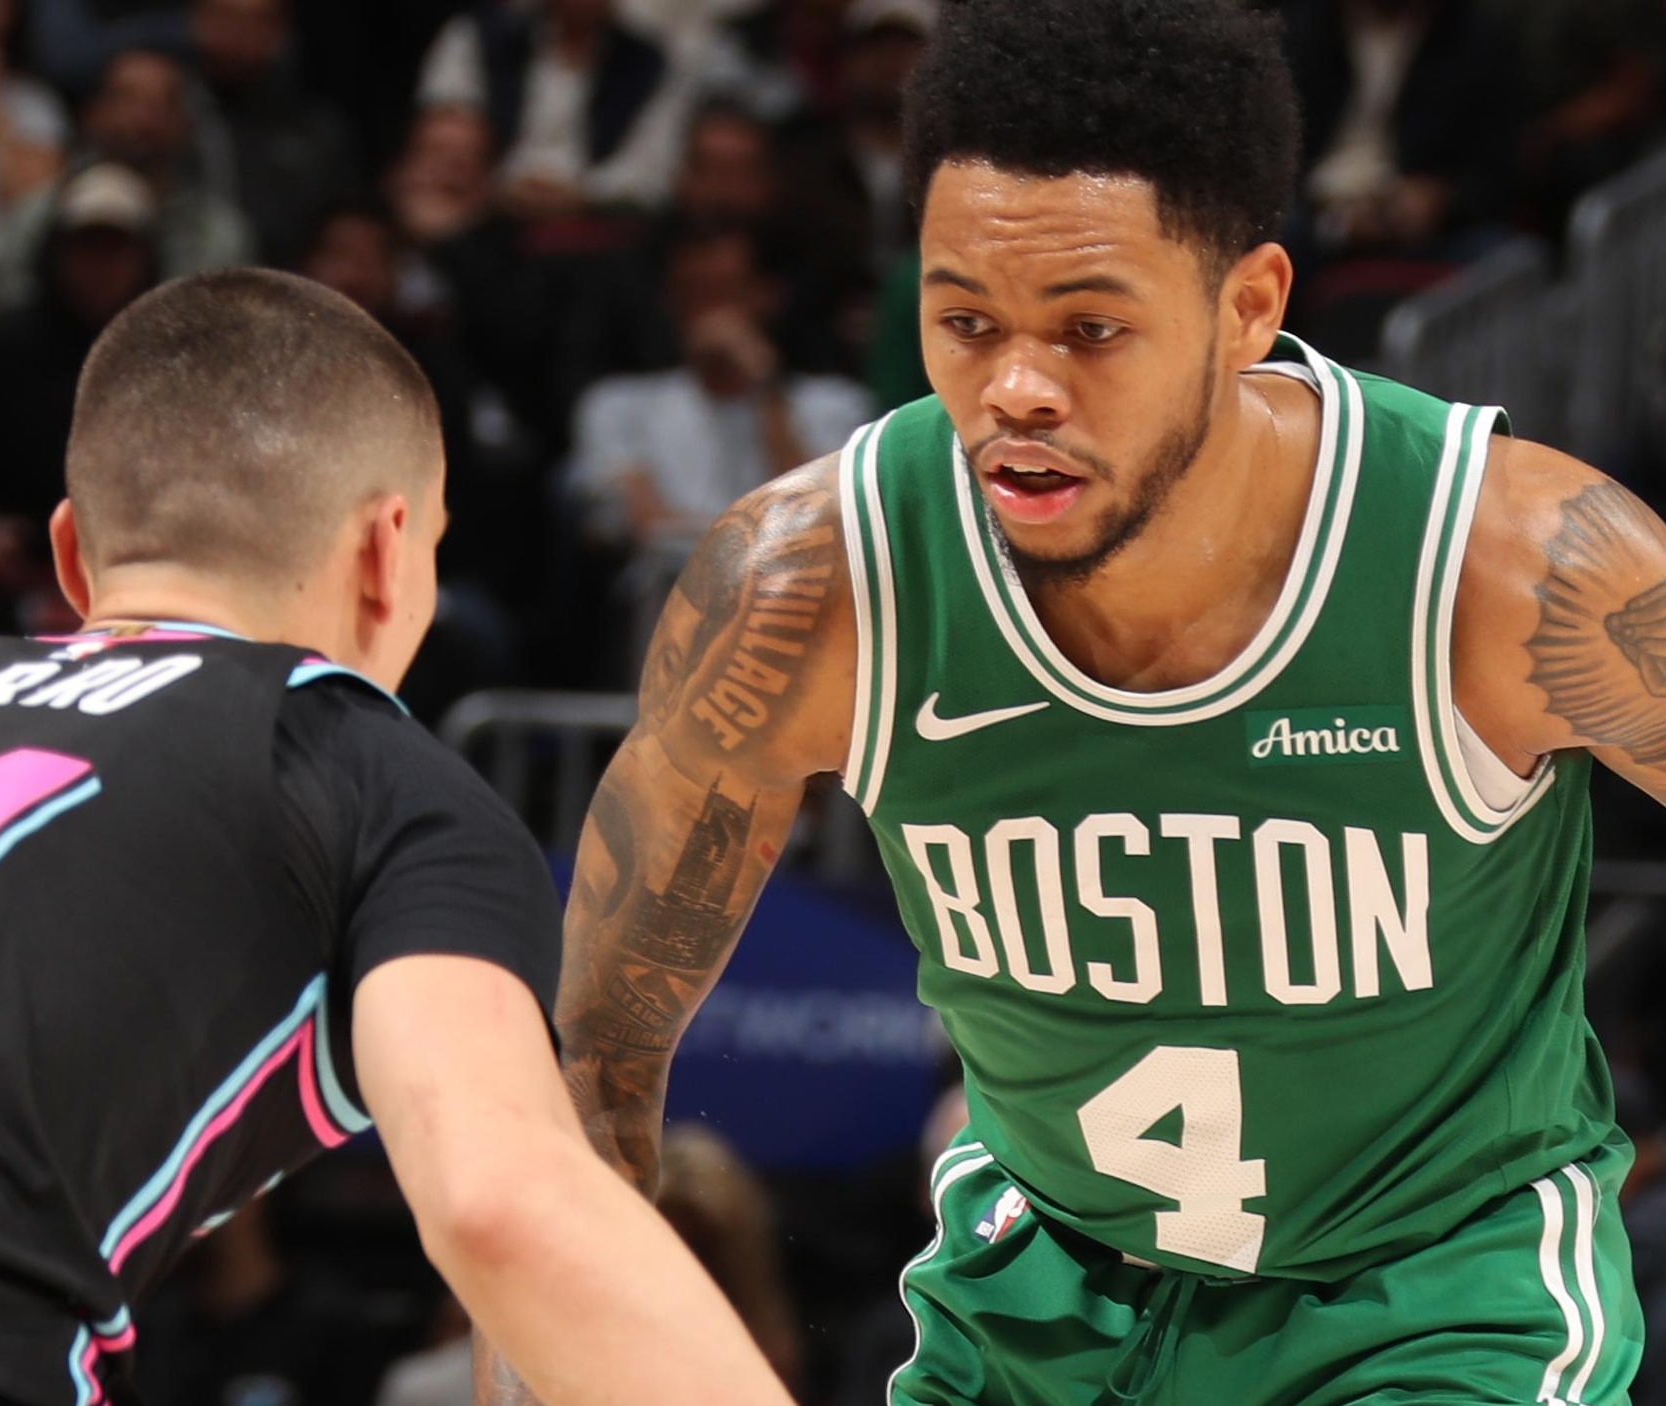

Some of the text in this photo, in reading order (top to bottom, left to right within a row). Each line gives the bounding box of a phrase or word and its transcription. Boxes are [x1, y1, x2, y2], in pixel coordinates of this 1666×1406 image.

[1252, 717, 1400, 758] Amica
[900, 813, 1433, 1006] BOSTON
[1076, 1045, 1266, 1273] 4
